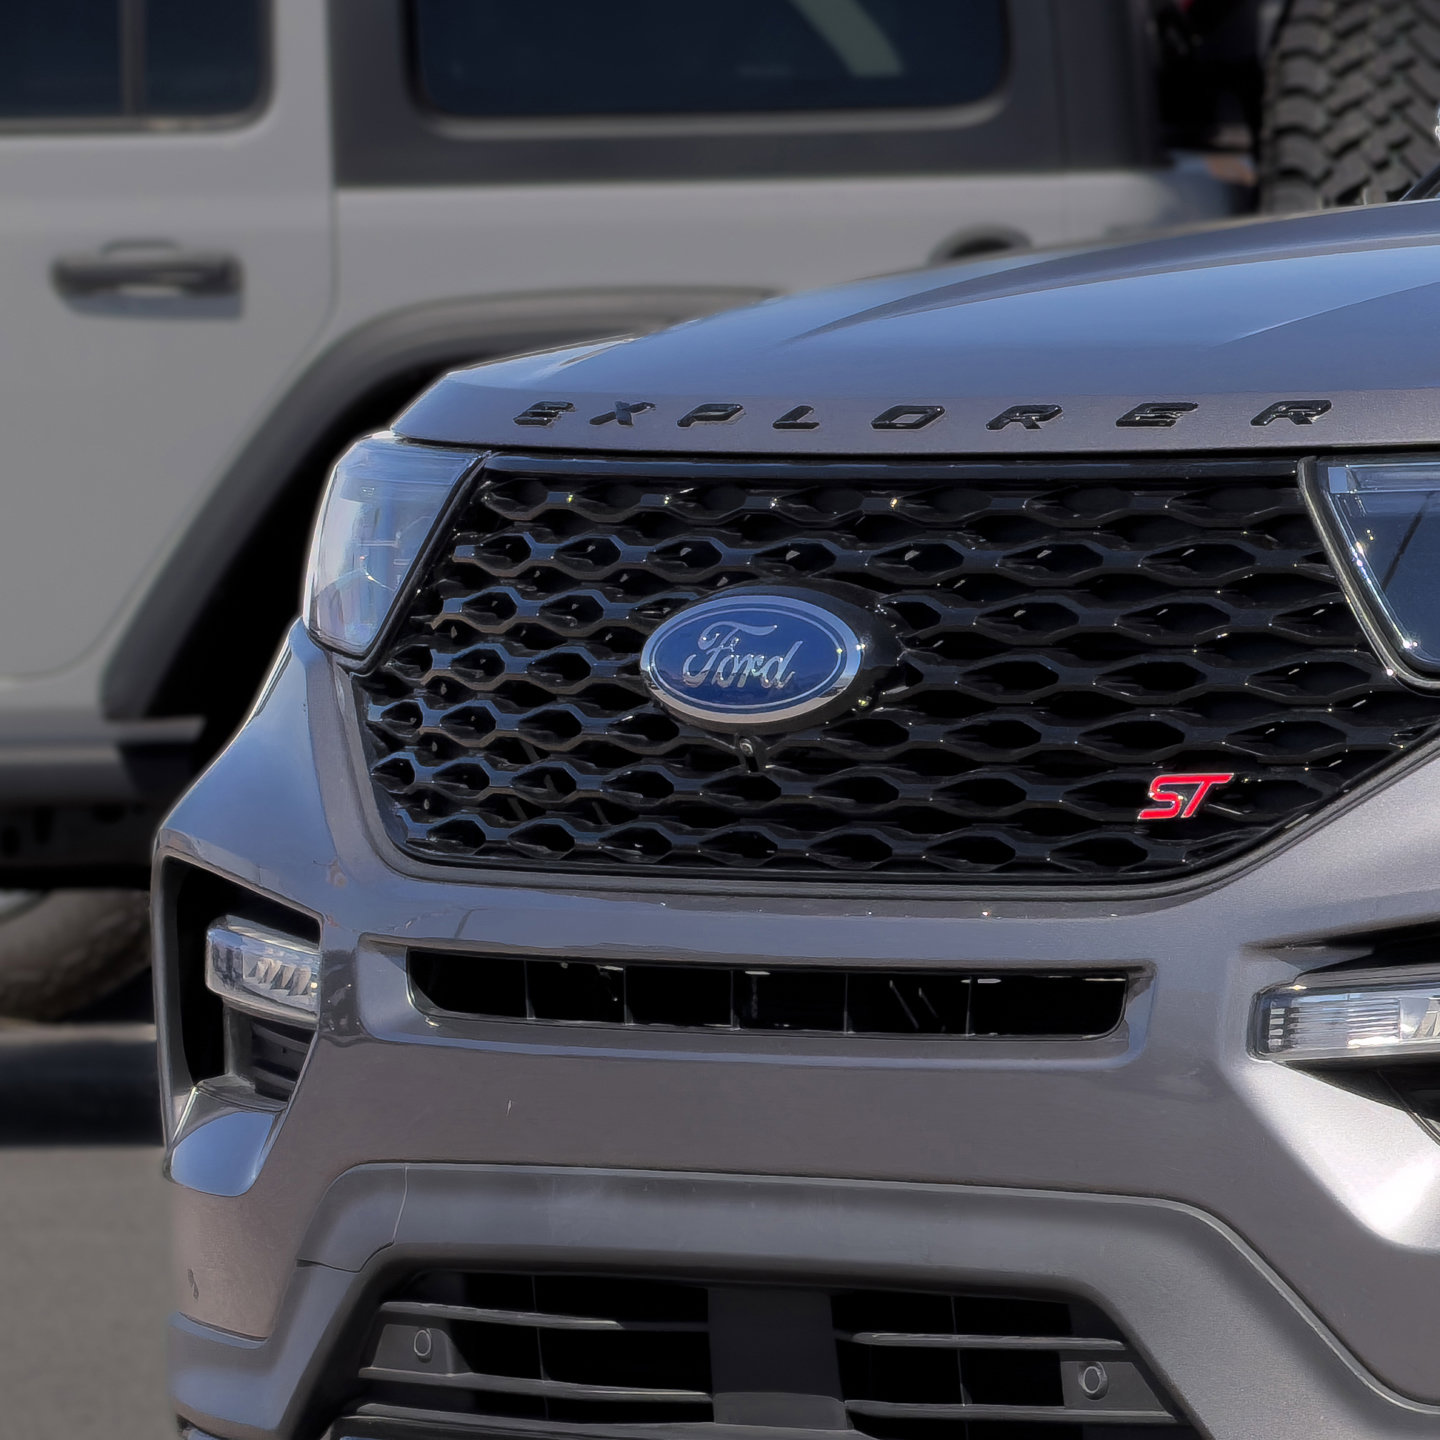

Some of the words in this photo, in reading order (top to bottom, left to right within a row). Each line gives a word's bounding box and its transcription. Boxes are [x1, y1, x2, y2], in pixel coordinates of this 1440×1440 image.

[513, 400, 1333, 432] EXPLORER
[682, 620, 804, 689] Ford
[1137, 771, 1235, 820] ST
